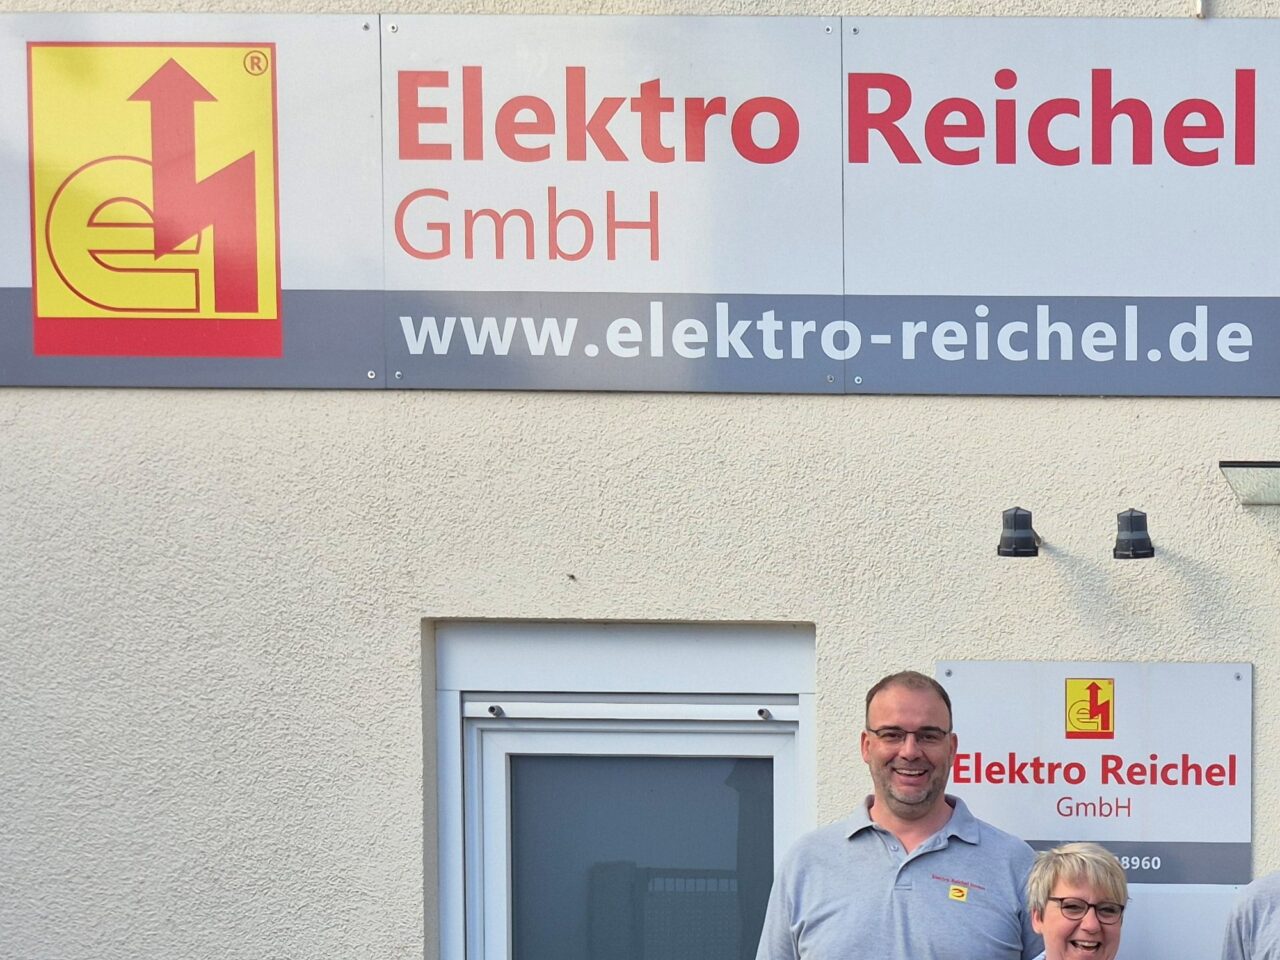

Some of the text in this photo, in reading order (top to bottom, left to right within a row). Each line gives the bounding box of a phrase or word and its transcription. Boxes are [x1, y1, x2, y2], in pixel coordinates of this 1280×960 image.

[397, 66, 1257, 167] Elektro Reichel
[394, 186, 660, 262] GmbH
[399, 301, 1254, 363] www.elektro-reichel.de
[953, 752, 1238, 787] Elektro Reichel
[1056, 796, 1132, 818] GmbH
